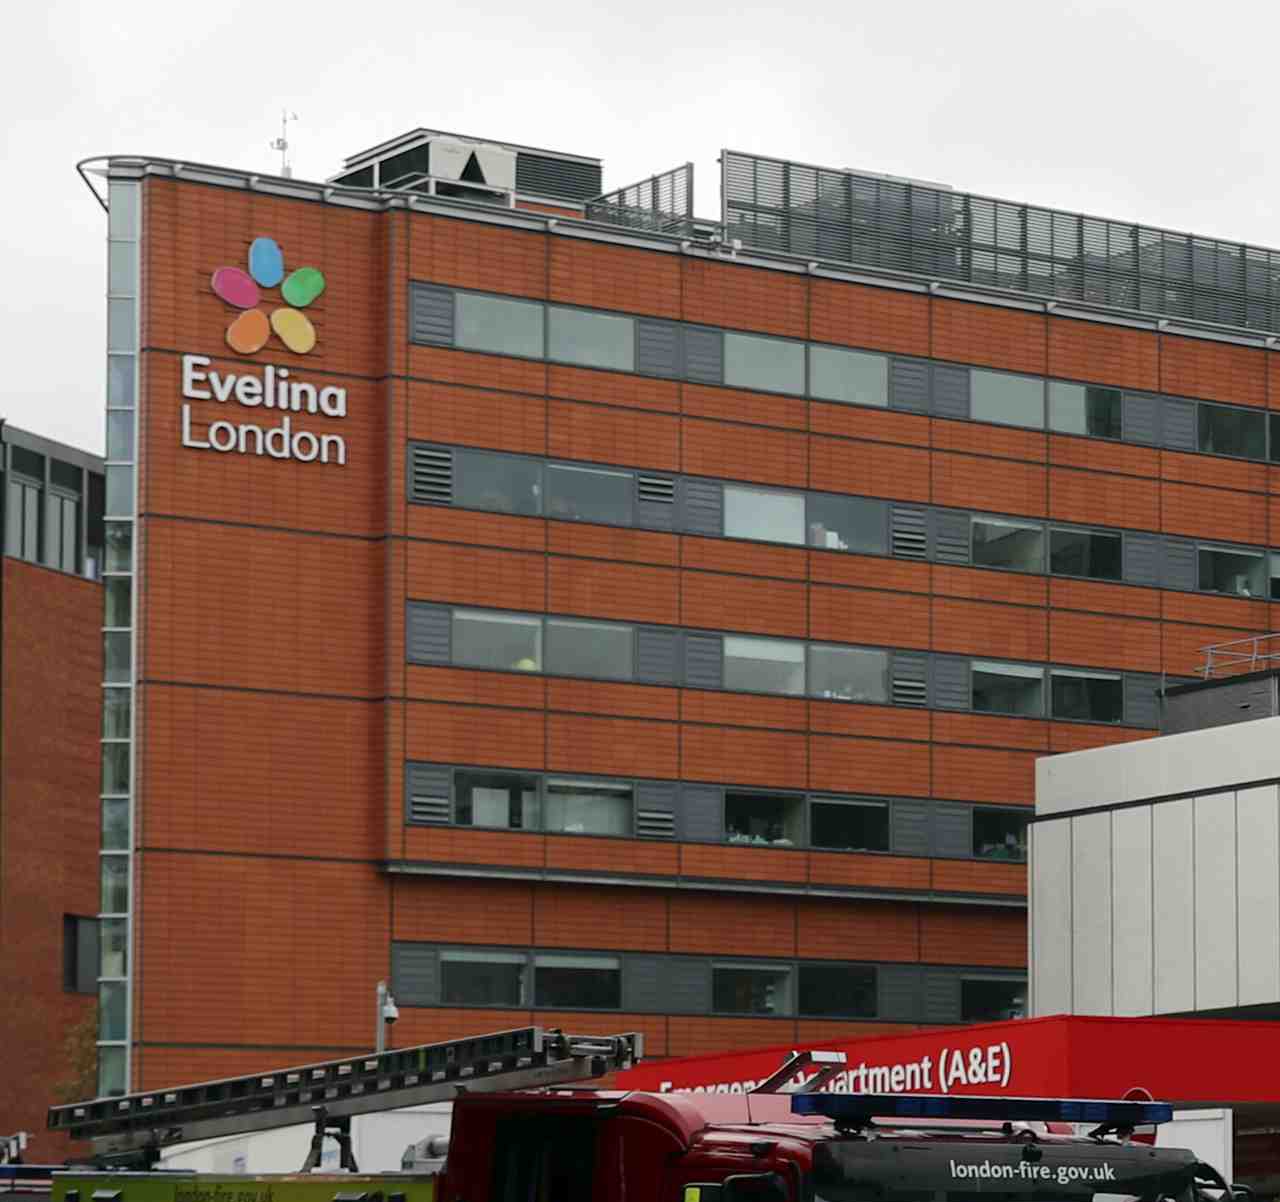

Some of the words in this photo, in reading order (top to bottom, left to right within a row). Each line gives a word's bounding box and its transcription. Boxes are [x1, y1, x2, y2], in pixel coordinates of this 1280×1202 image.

[182, 354, 347, 418] Evelina
[182, 403, 346, 465] London
[938, 1042, 1011, 1093] (A&E)
[950, 1159, 1117, 1185] london-fire.gov.uk
